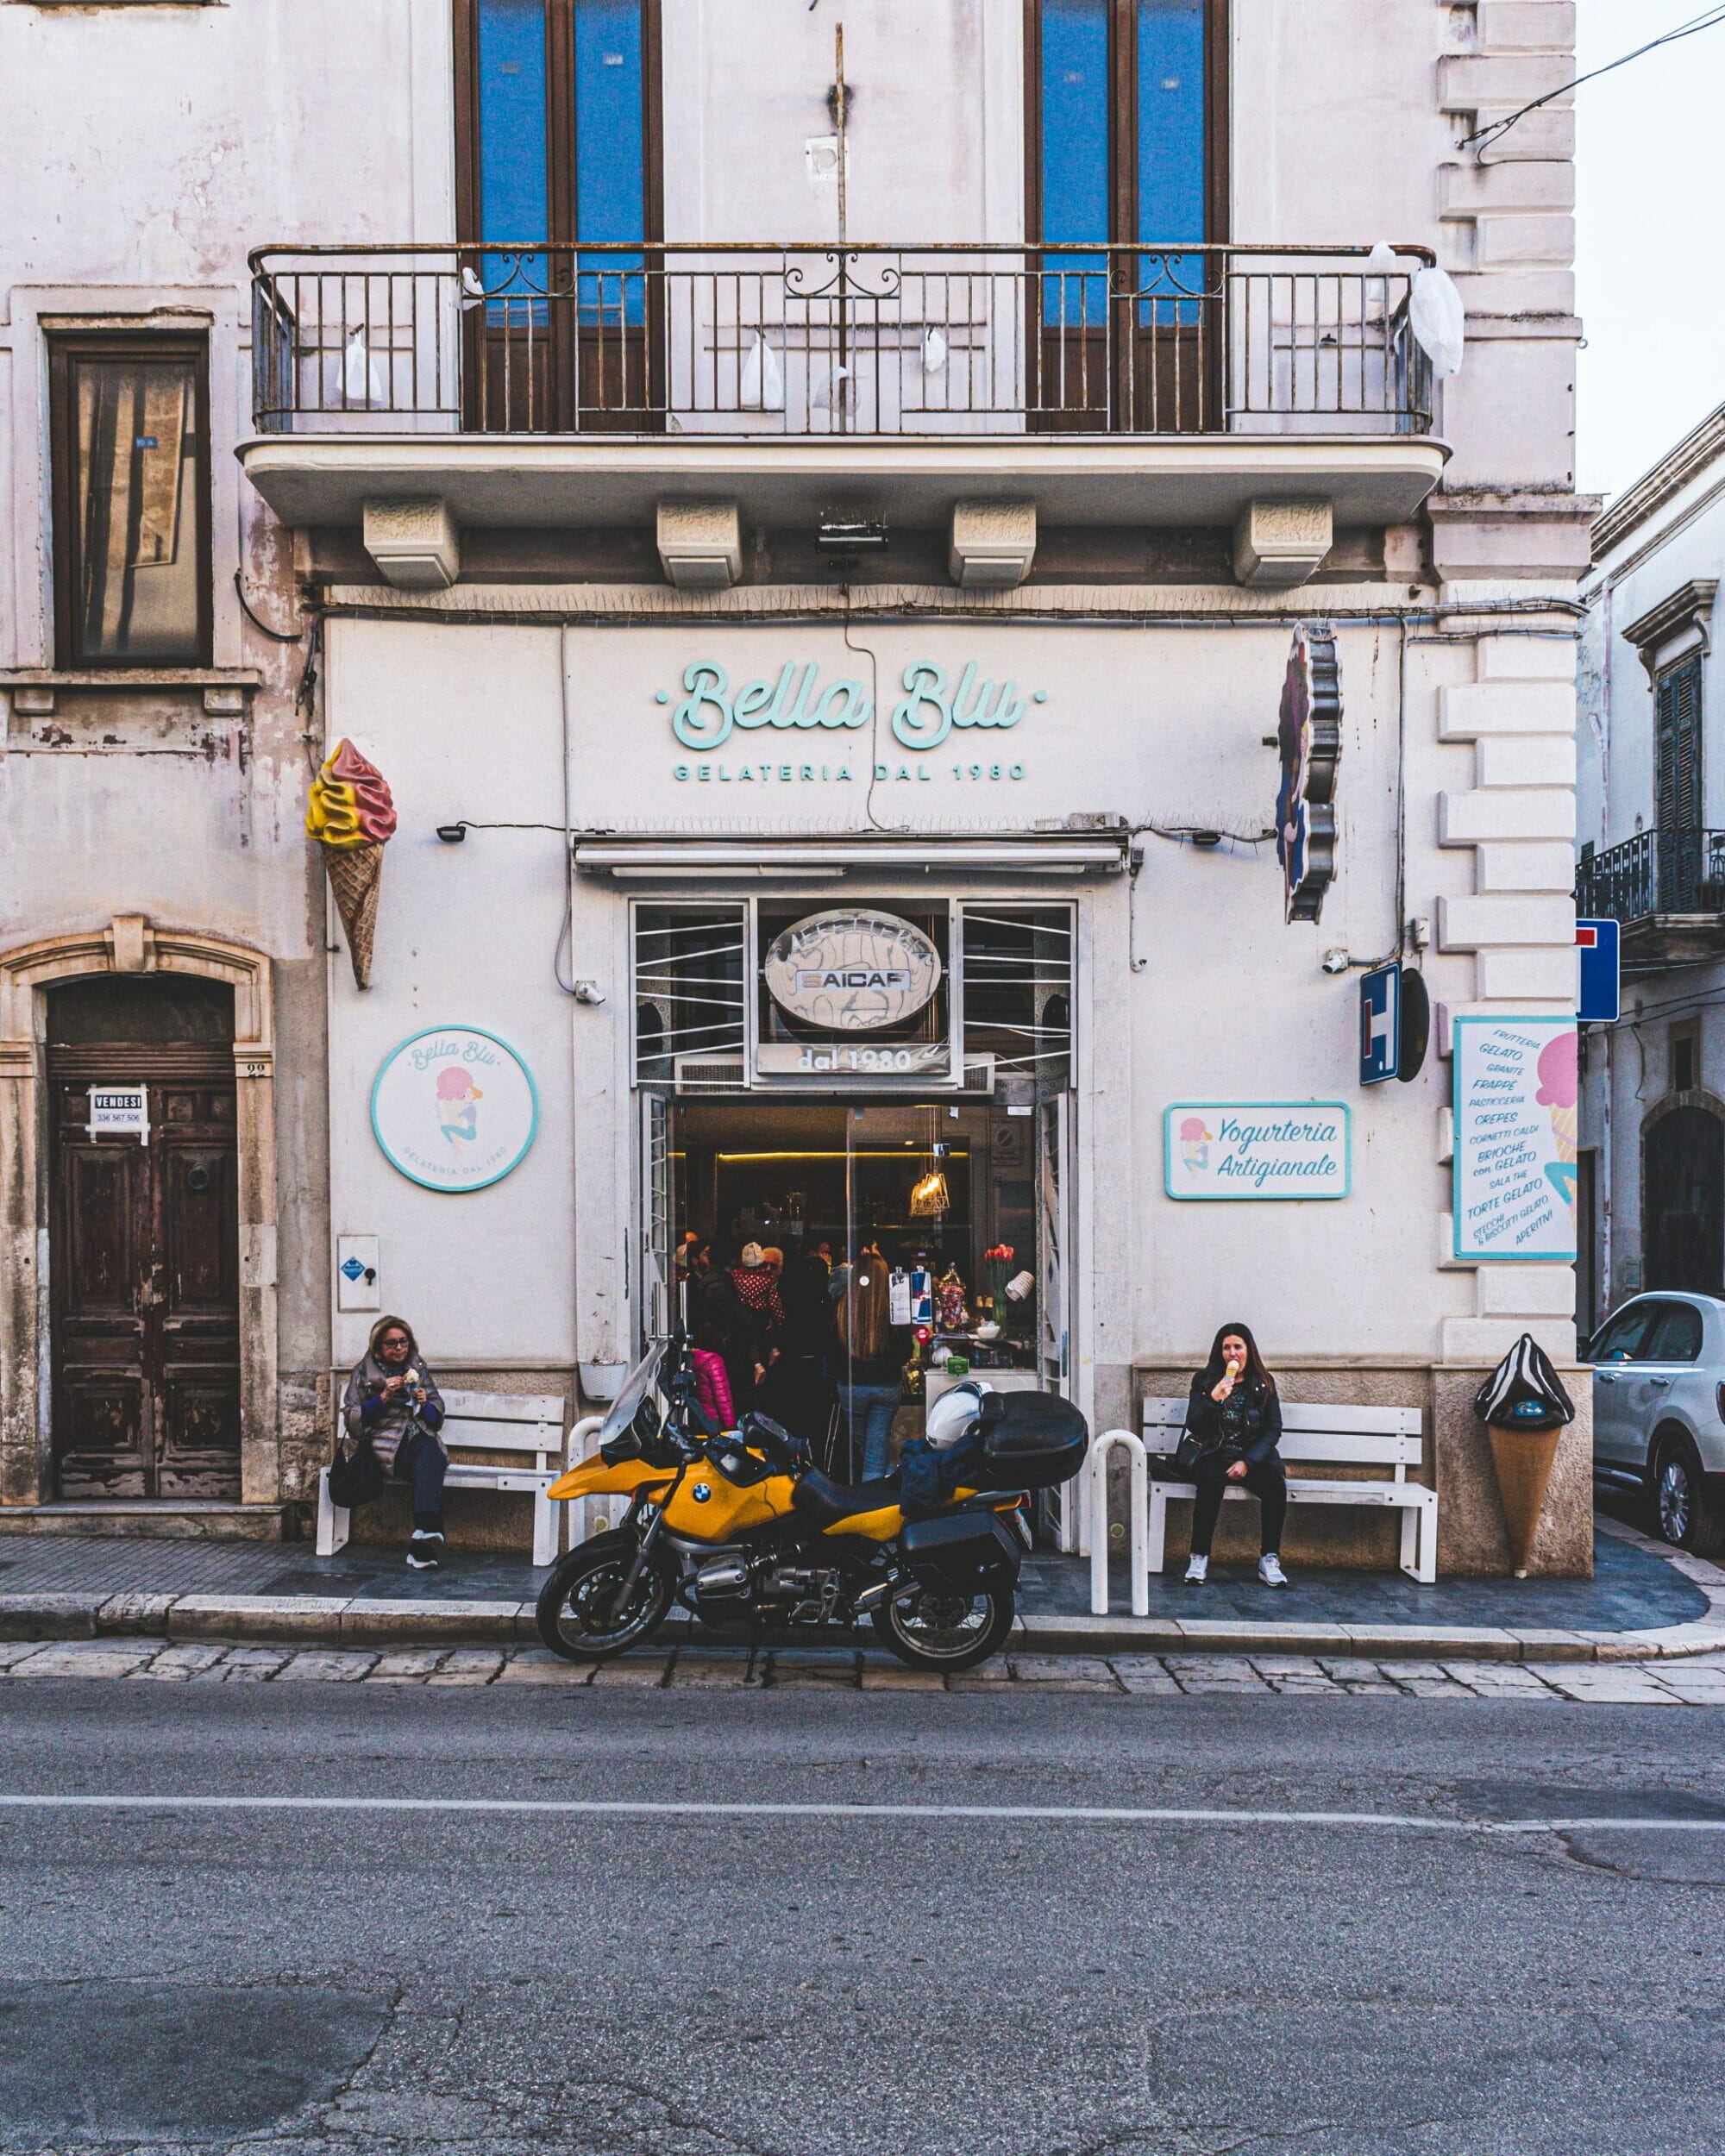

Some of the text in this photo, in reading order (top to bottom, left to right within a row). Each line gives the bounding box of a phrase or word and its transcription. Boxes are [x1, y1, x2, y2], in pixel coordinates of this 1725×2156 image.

[673, 660, 1026, 749] Bella Blu
[674, 764, 1025, 780] GELATERIA DAL 1980
[802, 973, 904, 988] SAICAF
[1492, 1030, 1540, 1050] FRUTTERIA
[411, 1039, 495, 1070] Bella Blu
[797, 1050, 911, 1070] dal 1980
[1479, 1044, 1523, 1061] GELATO
[1486, 1063, 1525, 1075] GRANITE
[96, 1096, 141, 1107] VENDESI
[1468, 1096, 1525, 1107] PASTICCERIA
[1475, 1112, 1518, 1125] CREPES
[1218, 1119, 1337, 1155] Yogurteria
[1470, 1125, 1539, 1144] CORNETTI CALDI
[403, 1146, 457, 1175] GELATERIA
[1477, 1140, 1527, 1163] BRIOCHE
[1217, 1154, 1337, 1188] Artigianale
[1473, 1151, 1537, 1176] con GELATO
[1489, 1175, 1510, 1189] SALA
[1467, 1178, 1543, 1219] TORTE GELATO
[1473, 1213, 1504, 1240] STECCHI
[1484, 1215, 1519, 1242] BISCOTTI
[1520, 1194, 1548, 1218] GELATO
[1515, 1209, 1552, 1245] APERITIVI
